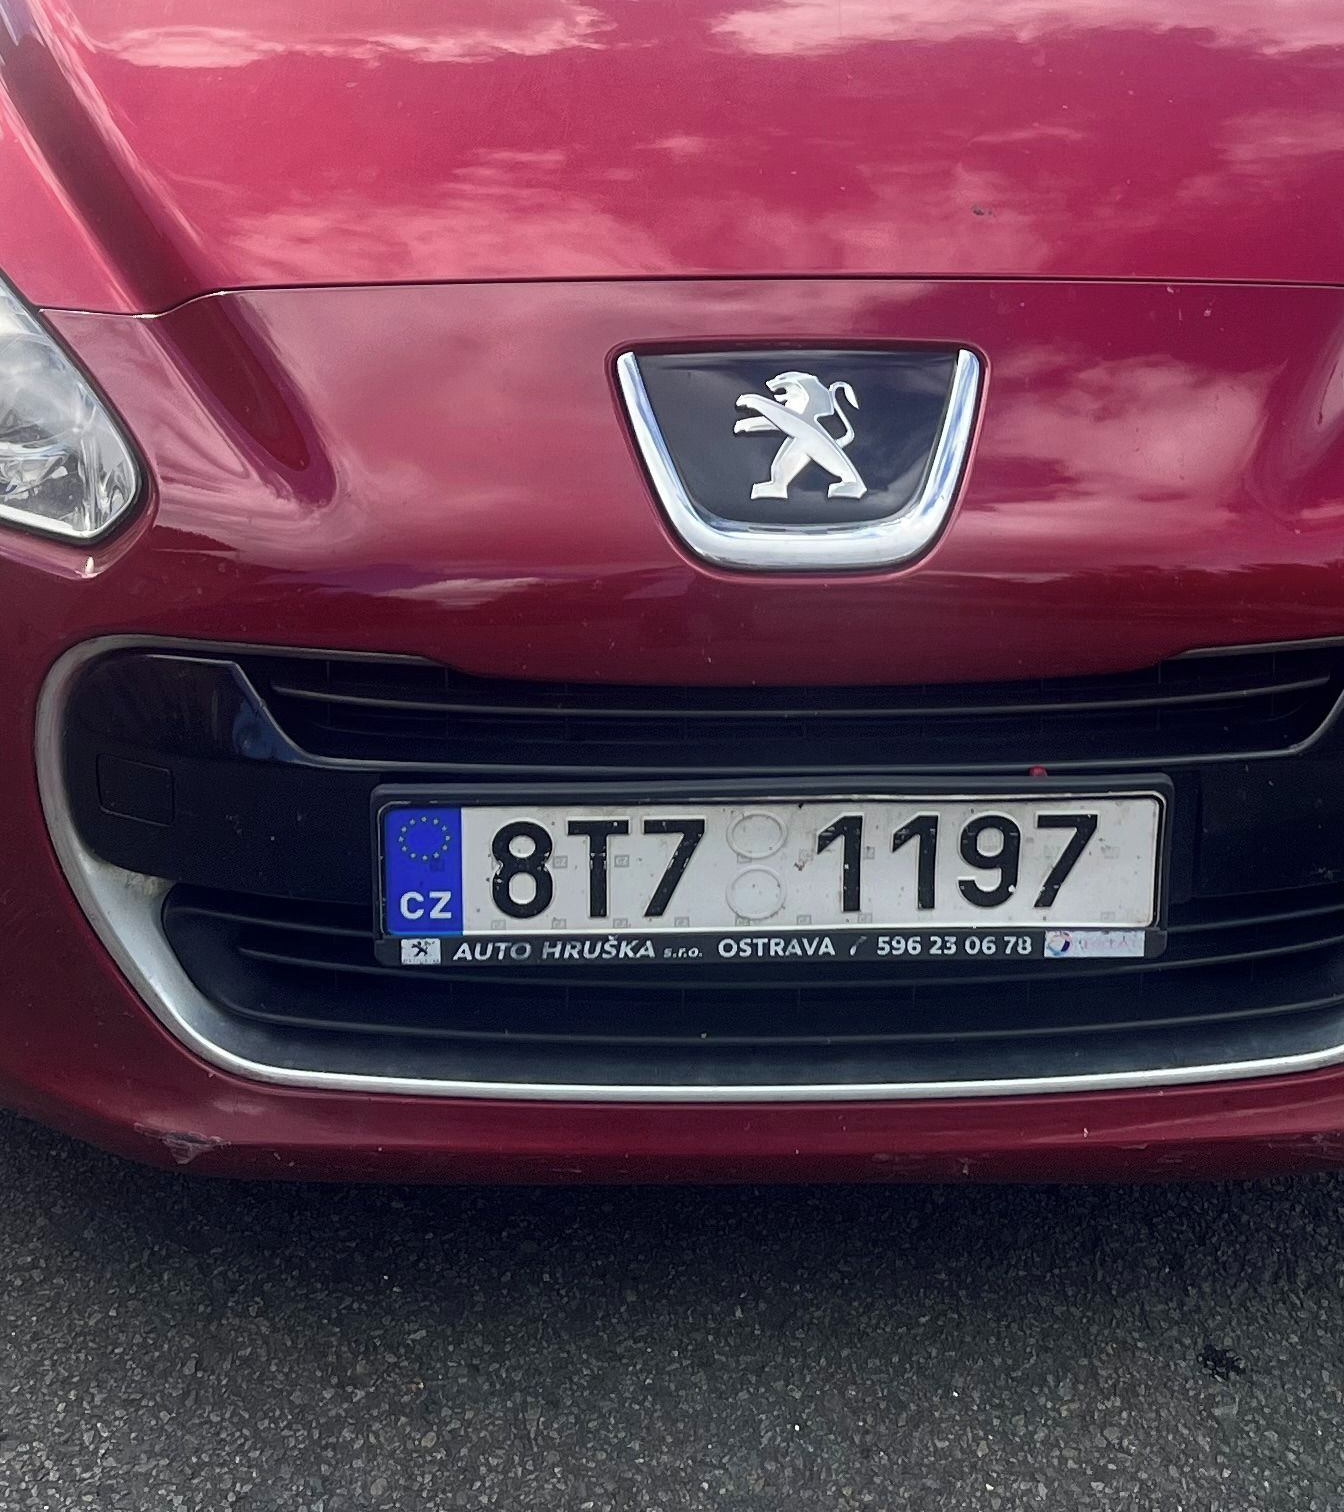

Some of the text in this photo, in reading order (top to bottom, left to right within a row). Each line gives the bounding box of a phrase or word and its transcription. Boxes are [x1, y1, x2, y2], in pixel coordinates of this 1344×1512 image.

[491, 813, 1099, 920] 8T7 1197
[399, 890, 452, 920] CZ
[452, 934, 1032, 961] AUTO HRUŠKA s.r.o. OSTRAVA 596 23 06 78
